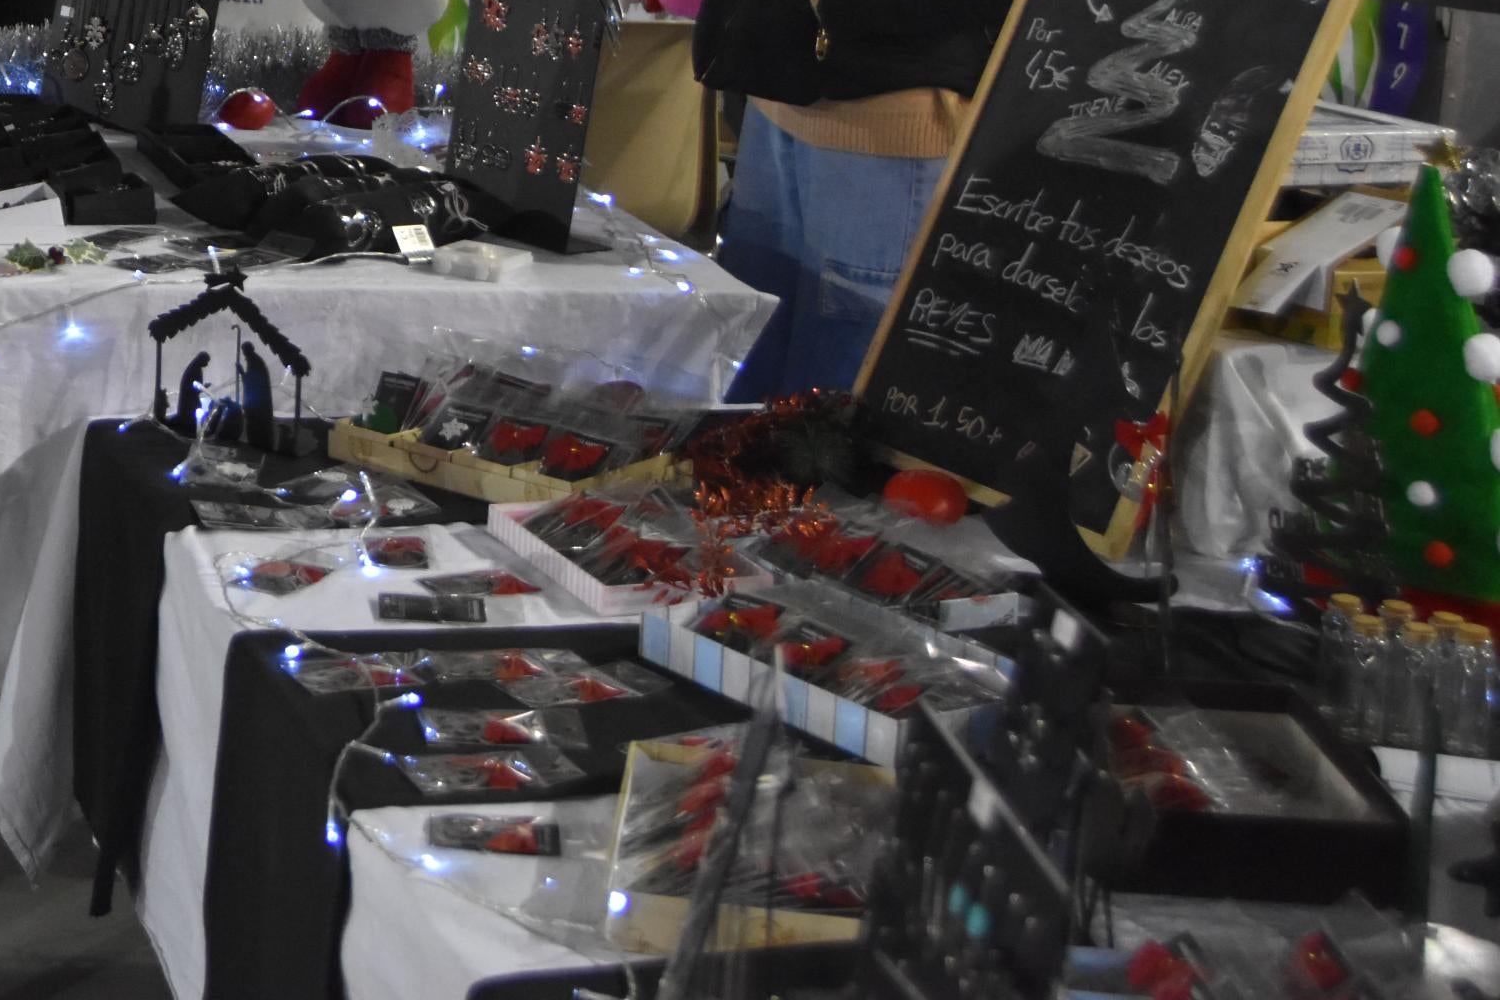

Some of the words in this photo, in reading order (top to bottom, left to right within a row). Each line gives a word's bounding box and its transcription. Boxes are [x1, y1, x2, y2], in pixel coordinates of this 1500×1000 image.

[932, 232, 992, 268] para
[953, 173, 1054, 233] Escribe
[1058, 199, 1102, 250] tus
[1103, 215, 1192, 289] deseos
[908, 287, 997, 344] REYES
